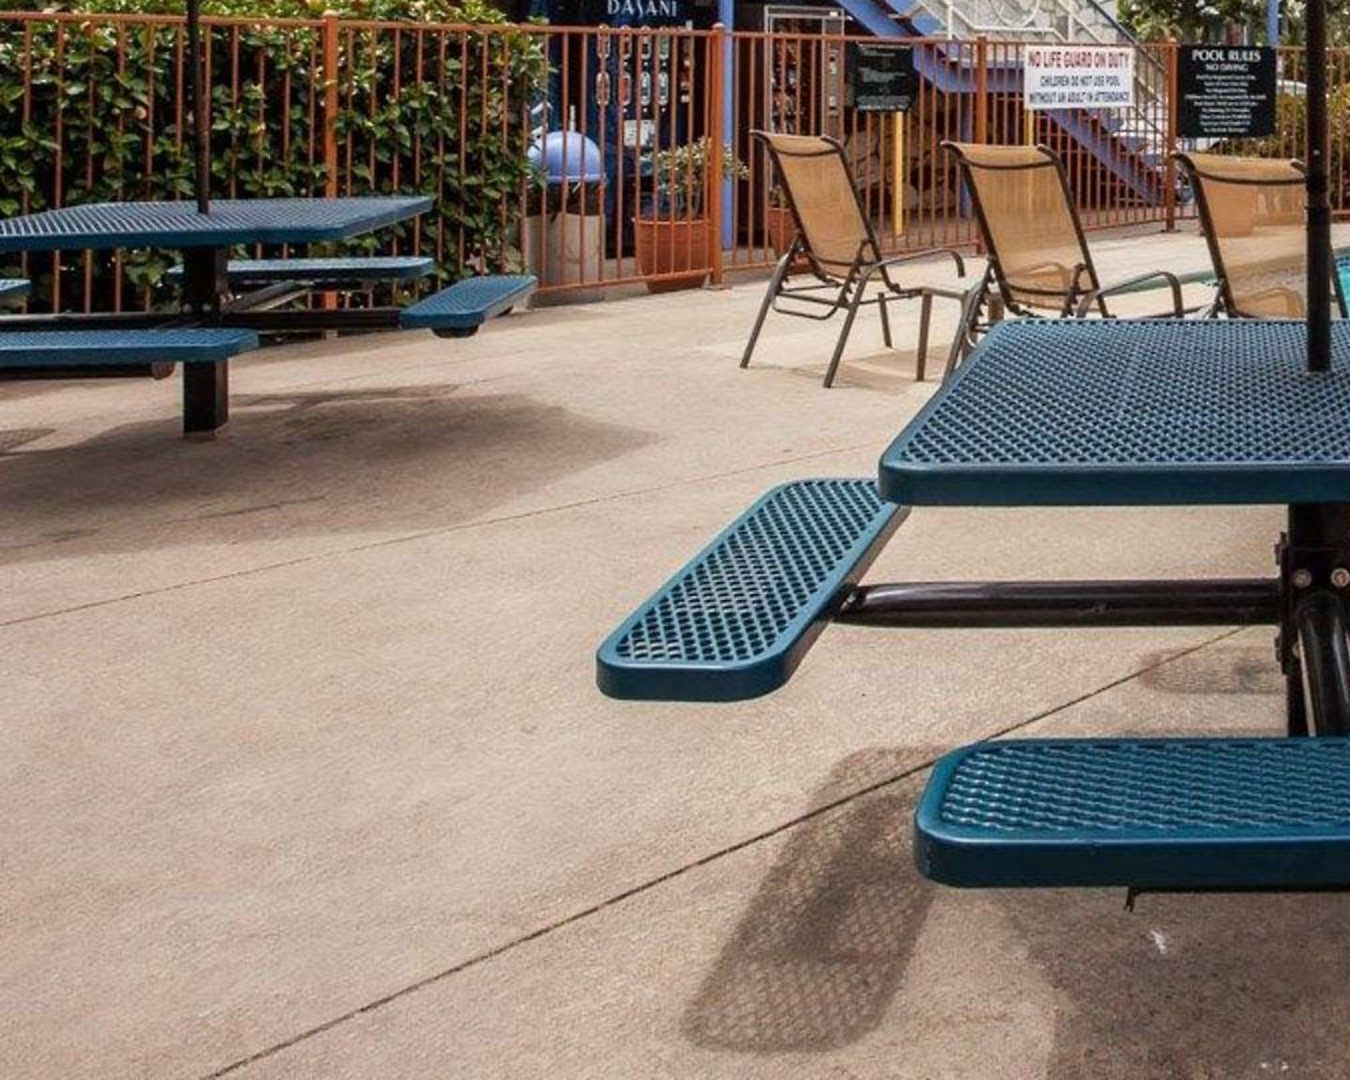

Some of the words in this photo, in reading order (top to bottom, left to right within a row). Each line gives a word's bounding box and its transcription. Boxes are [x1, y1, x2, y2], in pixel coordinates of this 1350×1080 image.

[1028, 51, 1041, 68] NO
[1043, 52, 1062, 68] LIFE
[1064, 52, 1092, 68] GUARD
[1095, 52, 1106, 68] ON
[1108, 52, 1129, 69] DUTY
[1192, 50, 1225, 61] POOL
[1228, 50, 1261, 62] RULES
[1205, 63, 1219, 71] NO
[1220, 63, 1249, 72] DIVING
[1040, 75, 1069, 87] CHILDREN
[1071, 75, 1079, 87] DO
[1080, 75, 1092, 87] NOT
[1094, 75, 1104, 87] USE
[1106, 75, 1120, 87] POOL
[1029, 91, 1056, 104] WITHOUT
[1058, 91, 1066, 103] AN
[1067, 91, 1085, 103] ADULT
[1086, 91, 1093, 103] IN
[1094, 91, 1130, 103] ATTENDANCE
